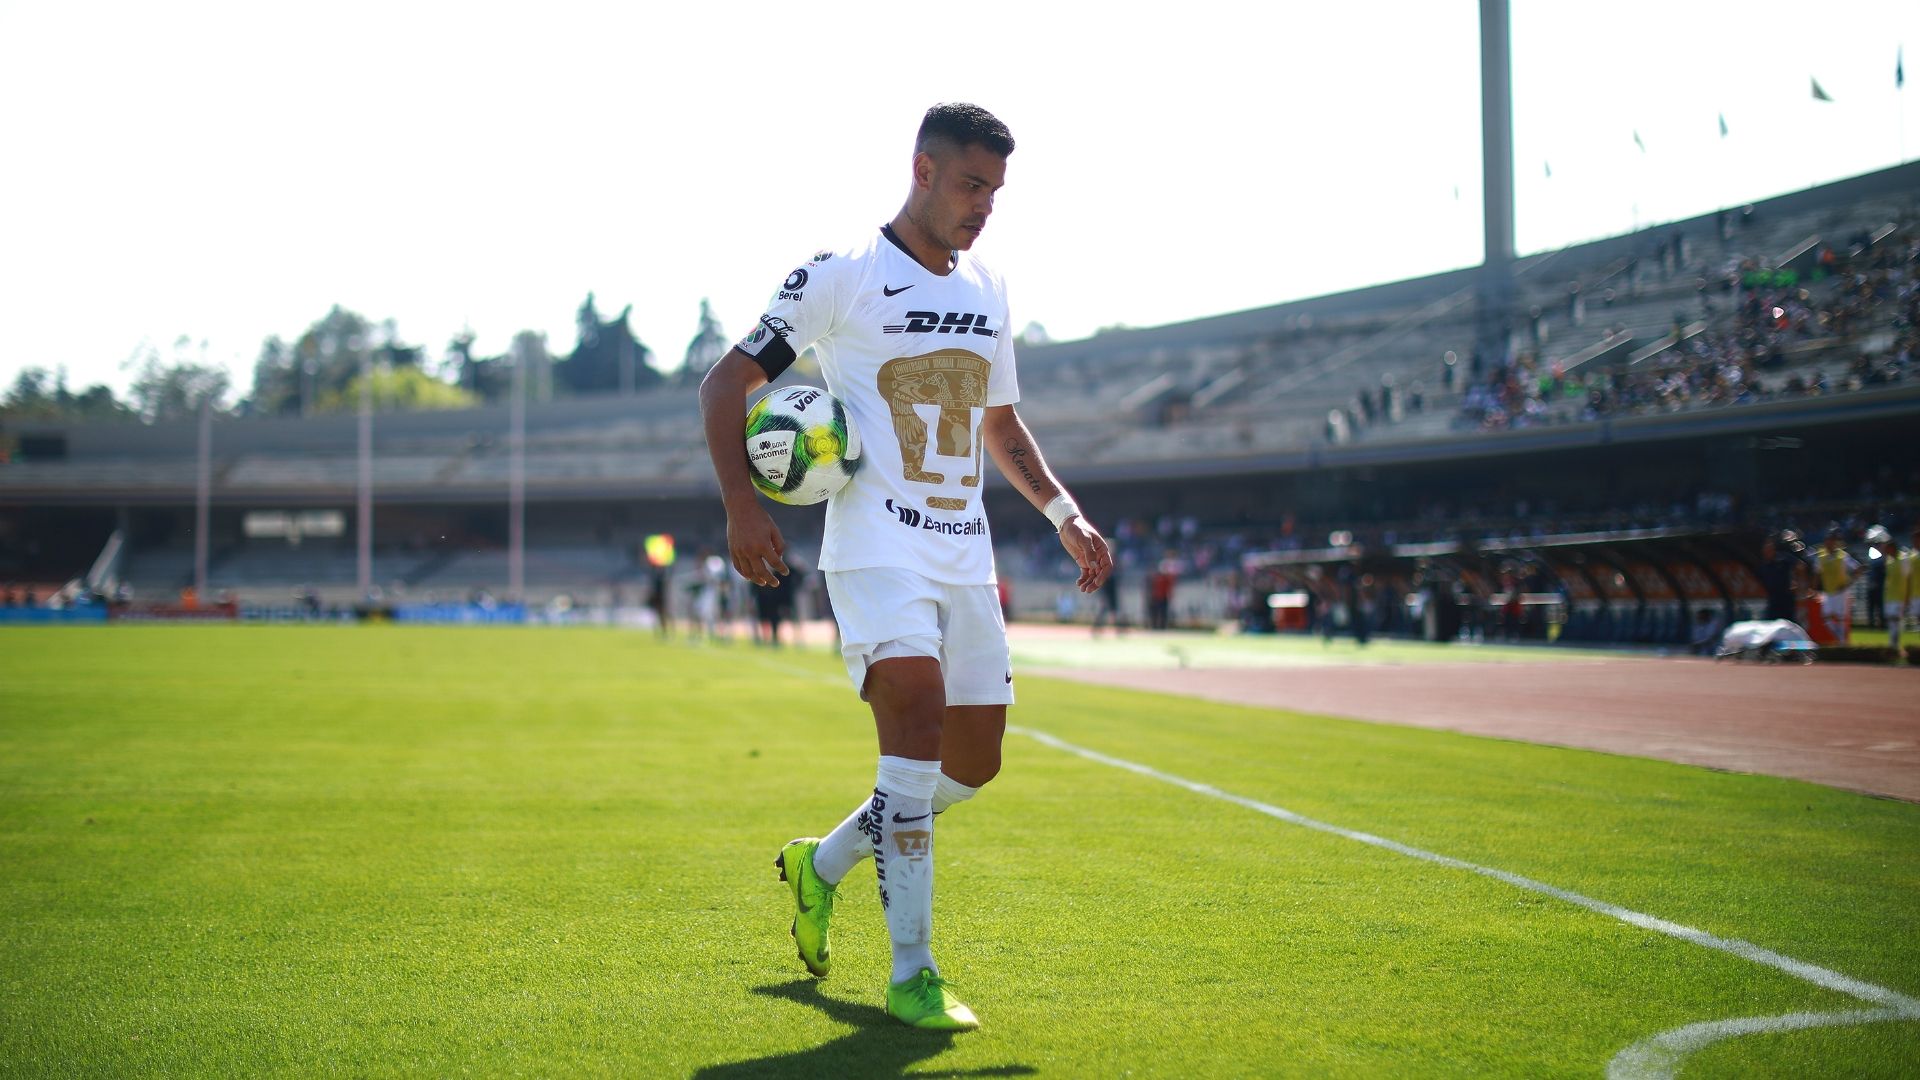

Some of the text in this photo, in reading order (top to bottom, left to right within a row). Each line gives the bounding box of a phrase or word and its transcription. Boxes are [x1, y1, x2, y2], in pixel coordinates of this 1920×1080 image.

[778, 290, 803, 302] Berel
[904, 311, 993, 337] DHL
[793, 390, 821, 412] Voit
[750, 448, 789, 461] Bancomer
